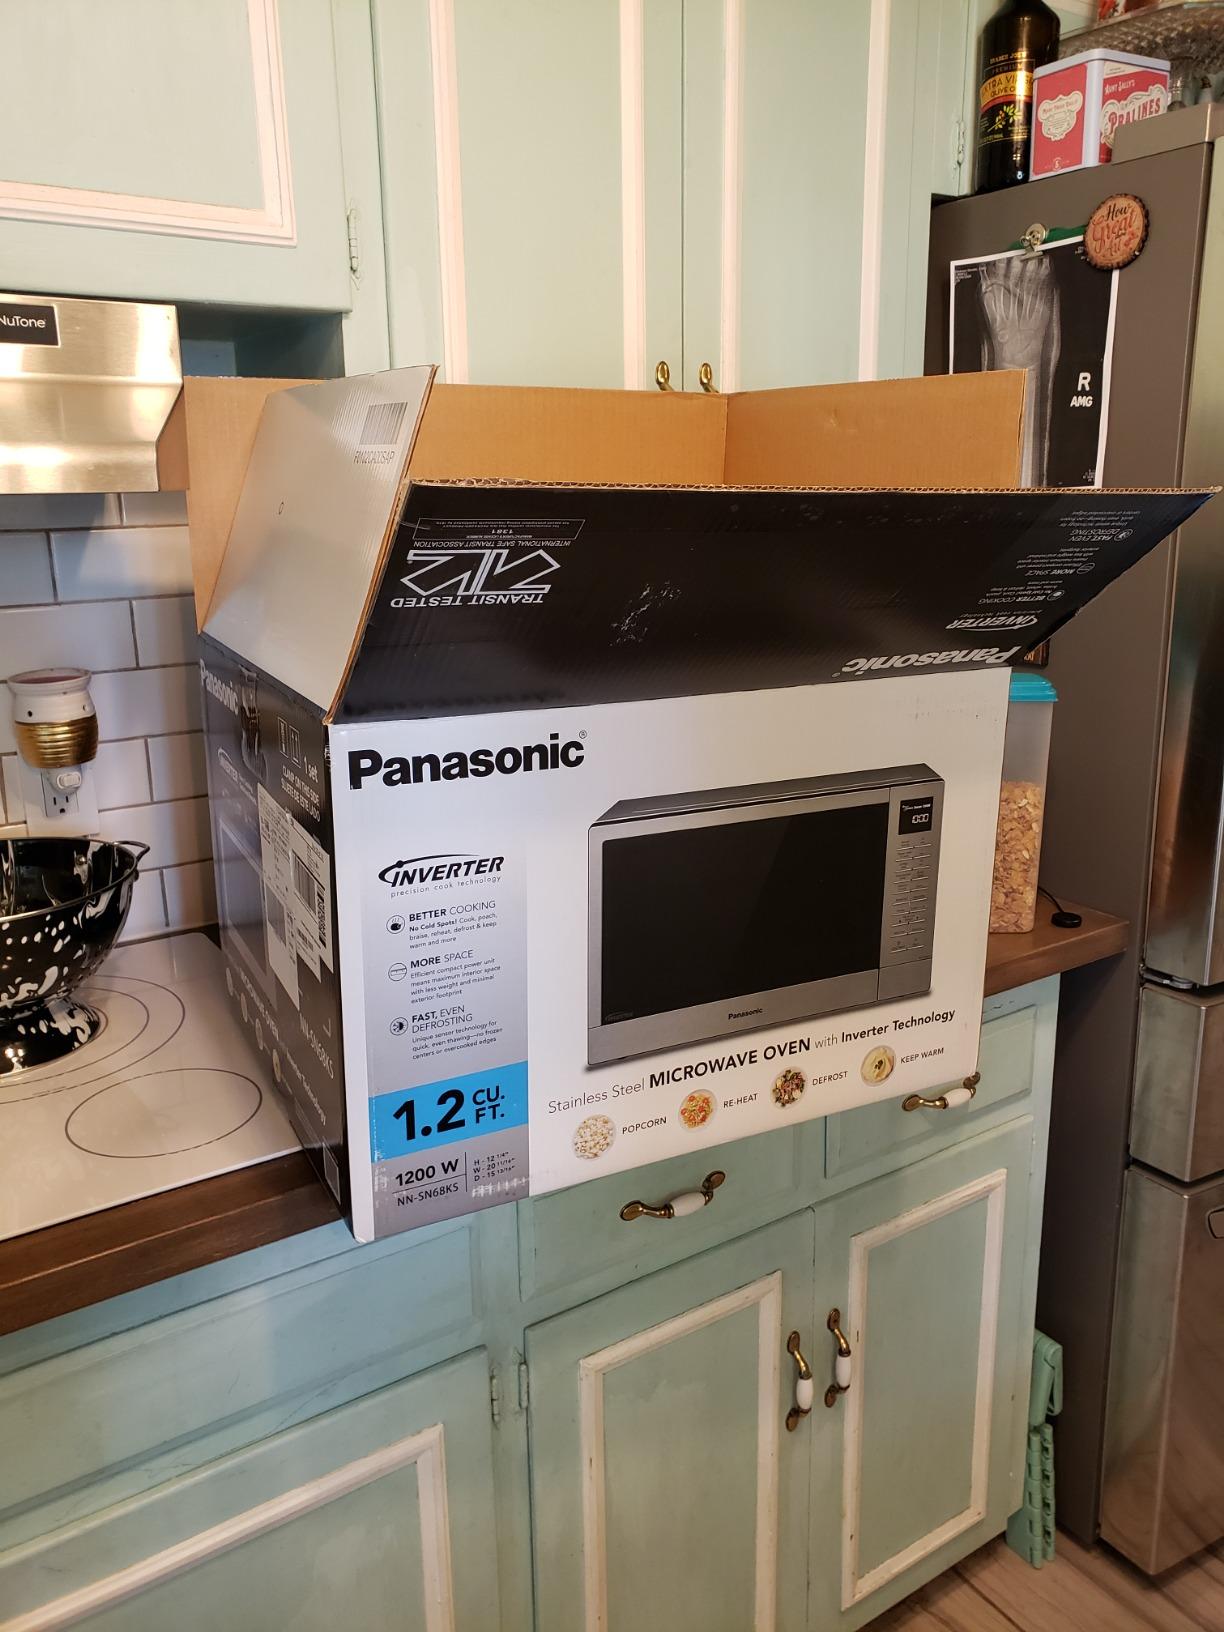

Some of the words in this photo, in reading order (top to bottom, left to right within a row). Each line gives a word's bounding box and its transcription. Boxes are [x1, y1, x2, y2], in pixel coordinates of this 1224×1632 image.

[1077, 372, 1092, 392] R
[1070, 396, 1093, 407] AMG
[390, 596, 463, 608] TESTED
[468, 594, 543, 605] TRANSIT
[945, 615, 1038, 630] INVERTER
[842, 646, 1021, 676] Panasonic
[200, 658, 239, 716] Panasonic
[348, 733, 585, 790] Panasonic
[380, 854, 505, 888] INVERTER
[390, 886, 430, 899] precision
[434, 881, 453, 891] cook
[457, 875, 501, 887] technology
[409, 908, 447, 922] BETTER
[449, 900, 496, 916] COOKING
[420, 922, 435, 931] Cold
[410, 956, 441, 969] MORE
[444, 949, 474, 963] SPACE
[411, 987, 424, 996] with
[436, 989, 463, 1000] footprint
[411, 1010, 438, 1023] FAST,
[440, 1004, 465, 1018] EVEN
[411, 1013, 473, 1034] DEFROSTING
[728, 1007, 763, 1021] Panasonic
[412, 1034, 434, 1045] Unique
[455, 1022, 488, 1034] technology
[548, 1089, 608, 1114] Stainless
[612, 1077, 645, 1098] Steel
[649, 1050, 758, 1089] MICROWAVE
[763, 1037, 811, 1060] OVEN
[814, 1034, 838, 1049] with
[841, 1023, 890, 1043] Inverter
[892, 1008, 955, 1032] Technology
[900, 1052, 919, 1064] KEEP
[921, 1047, 944, 1059] WARM
[812, 1070, 849, 1086] DEFROST
[472, 1085, 505, 1106] CU.
[723, 1092, 759, 1108] RE-HEAT
[393, 1088, 466, 1141] 1.2
[475, 1104, 505, 1124] FT.
[622, 1116, 667, 1135] POPCORN
[395, 1165, 436, 1186] 1200
[441, 1158, 459, 1175] W
[397, 1182, 459, 1207] NN-SN68KS
